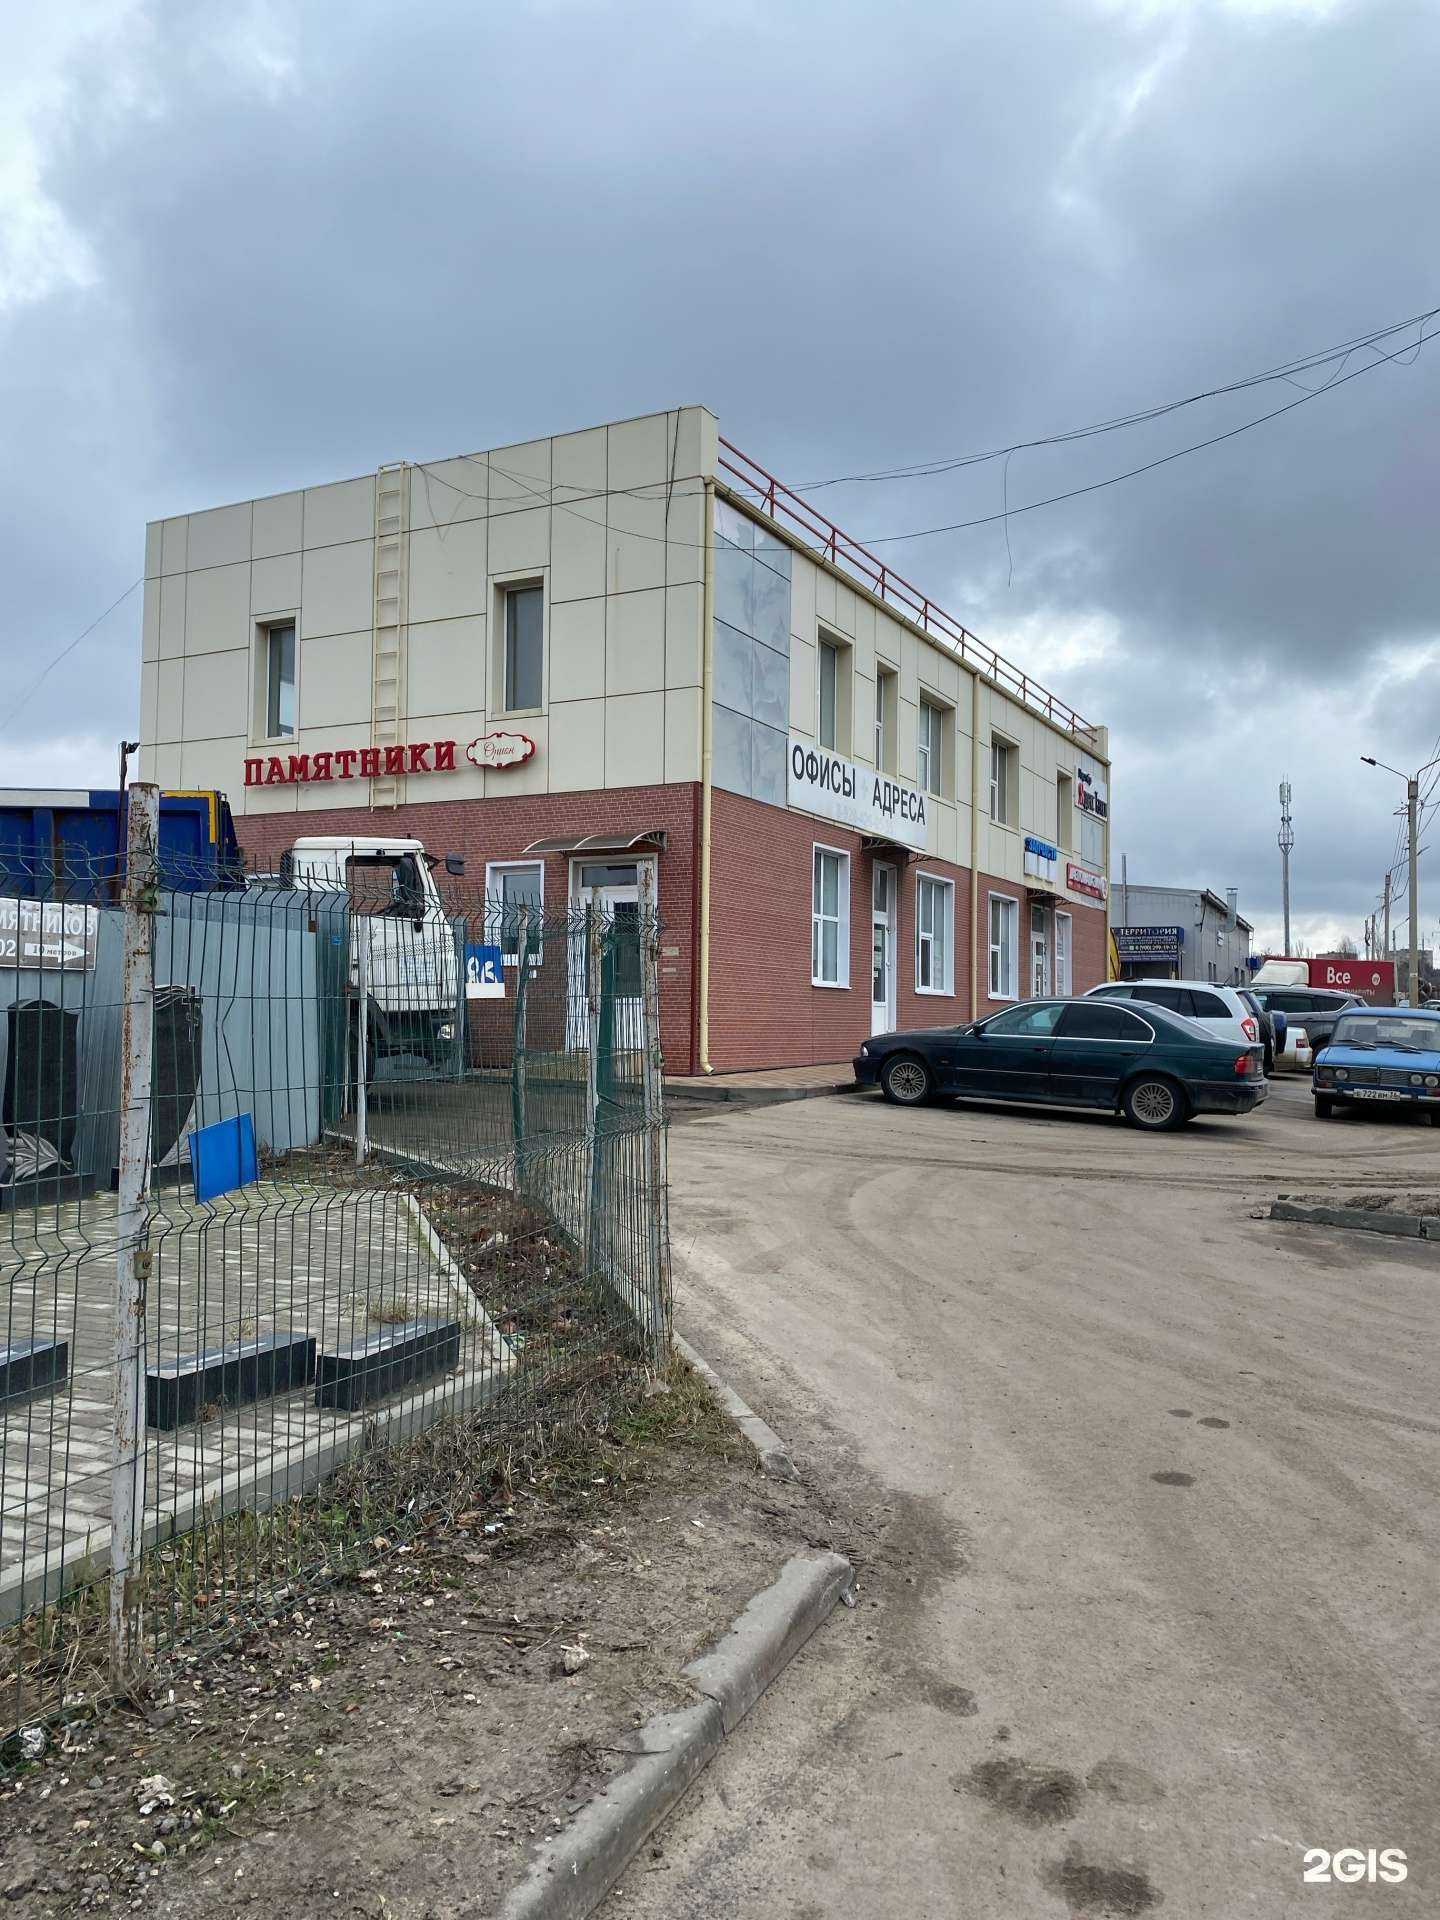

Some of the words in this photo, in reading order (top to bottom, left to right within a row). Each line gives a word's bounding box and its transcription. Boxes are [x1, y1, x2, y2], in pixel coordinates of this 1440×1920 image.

[243, 740, 457, 787] ПАМЯТНИКИ
[792, 744, 856, 800] ОФИСЫ
[872, 777, 926, 826] АДРЕСА
[1120, 927, 1178, 936] ТЕРРИТОРИЯ
[1326, 966, 1352, 985] Все
